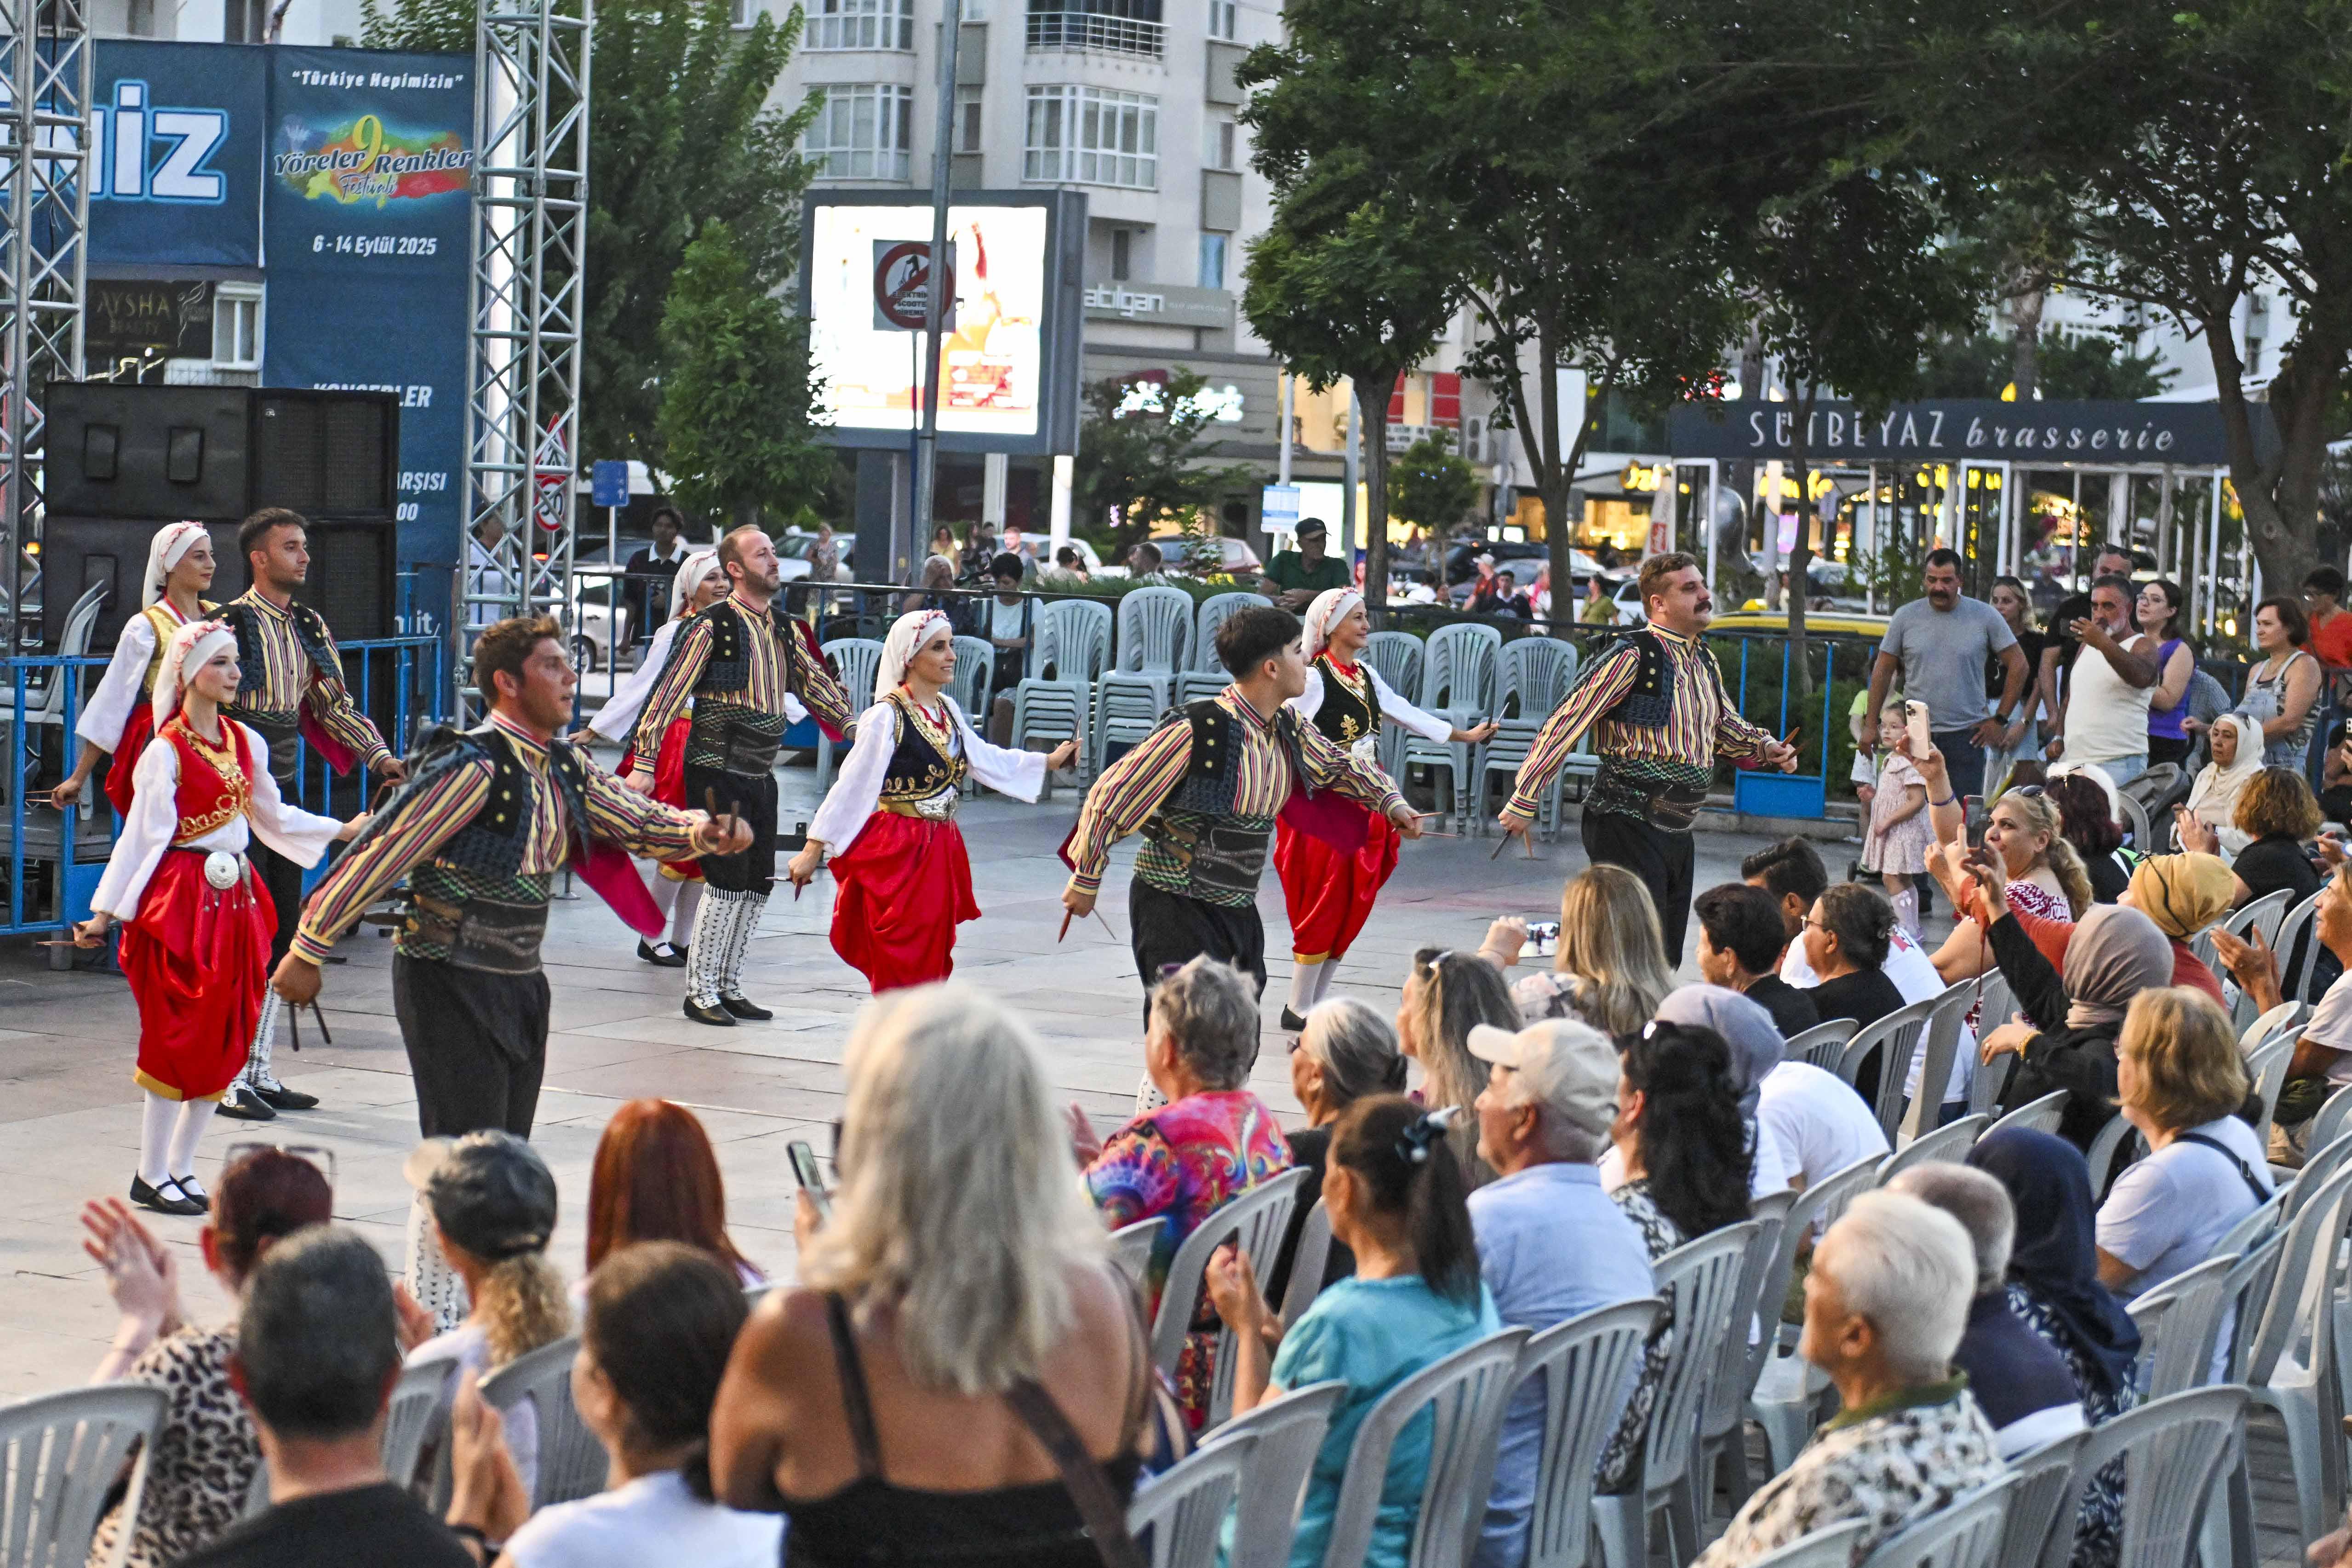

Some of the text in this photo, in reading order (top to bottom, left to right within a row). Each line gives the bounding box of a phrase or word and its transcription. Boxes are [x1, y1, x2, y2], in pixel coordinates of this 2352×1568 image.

[292, 70, 464, 90] “Türkiye Hepimizin”
[275, 148, 473, 176] Yöreler Renkler
[312, 235, 325, 252] 6
[335, 235, 352, 253] 14
[355, 235, 396, 257] Eylül
[397, 236, 437, 255] 2025
[1966, 417, 2173, 451] brasserie
[396, 503, 418, 521] 00
